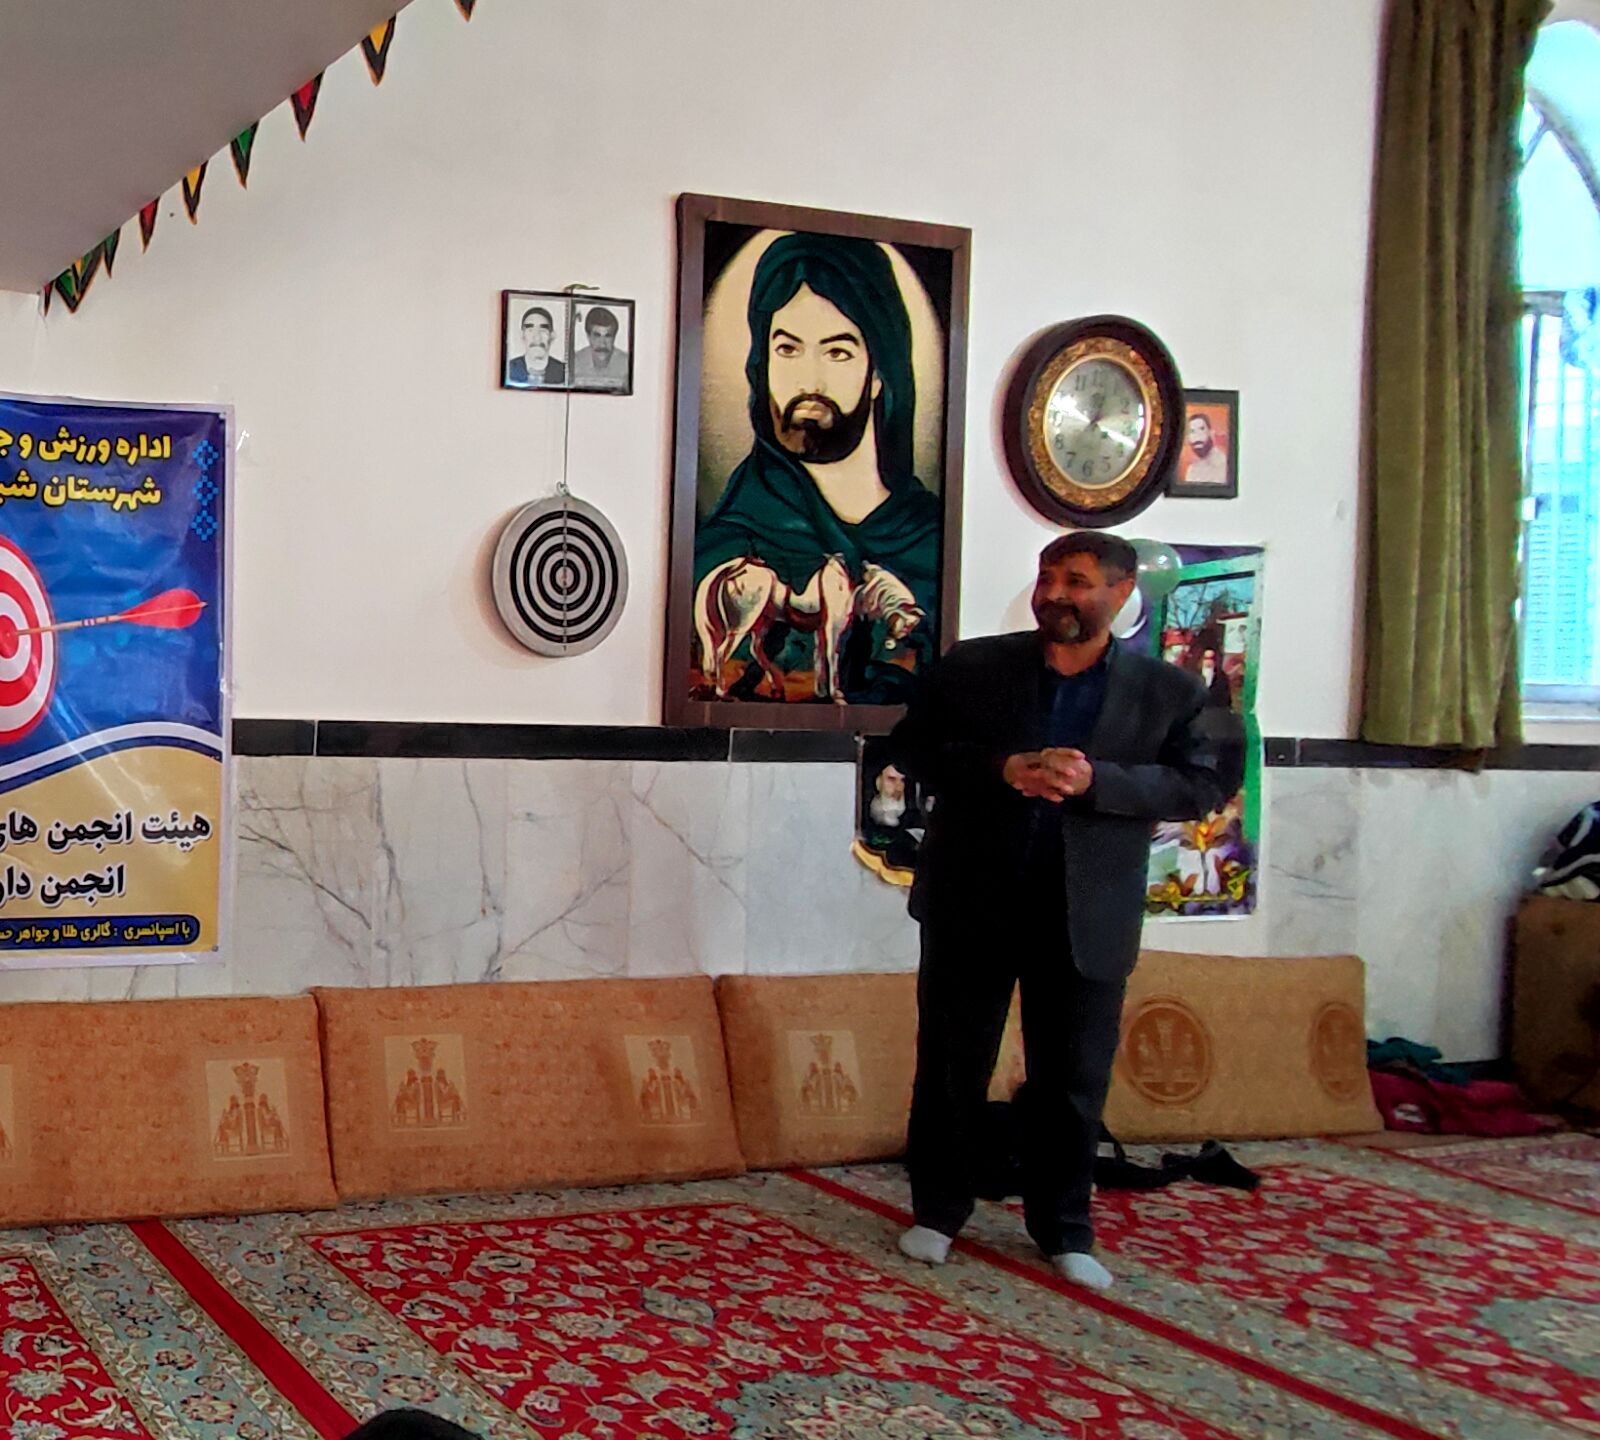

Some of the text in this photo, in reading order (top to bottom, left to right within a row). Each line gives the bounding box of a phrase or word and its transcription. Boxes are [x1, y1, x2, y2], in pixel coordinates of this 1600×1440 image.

[19, 433, 33, 459] و
[38, 426, 111, 464] ورزش
[115, 433, 171, 465] اداره
[1066, 451, 1076, 468] 7
[1082, 458, 1094, 477] 6
[43, 476, 161, 511] شهرستان
[47, 811, 133, 851] انجمن
[141, 811, 211, 850] هیئت
[40, 864, 125, 904] انجمن
[15, 927, 50, 943] جواهر
[52, 930, 60, 942] و
[62, 924, 77, 938] طلا
[80, 921, 112, 942] گالری
[123, 922, 179, 942] اسپانسری
[181, 921, 190, 935] با
